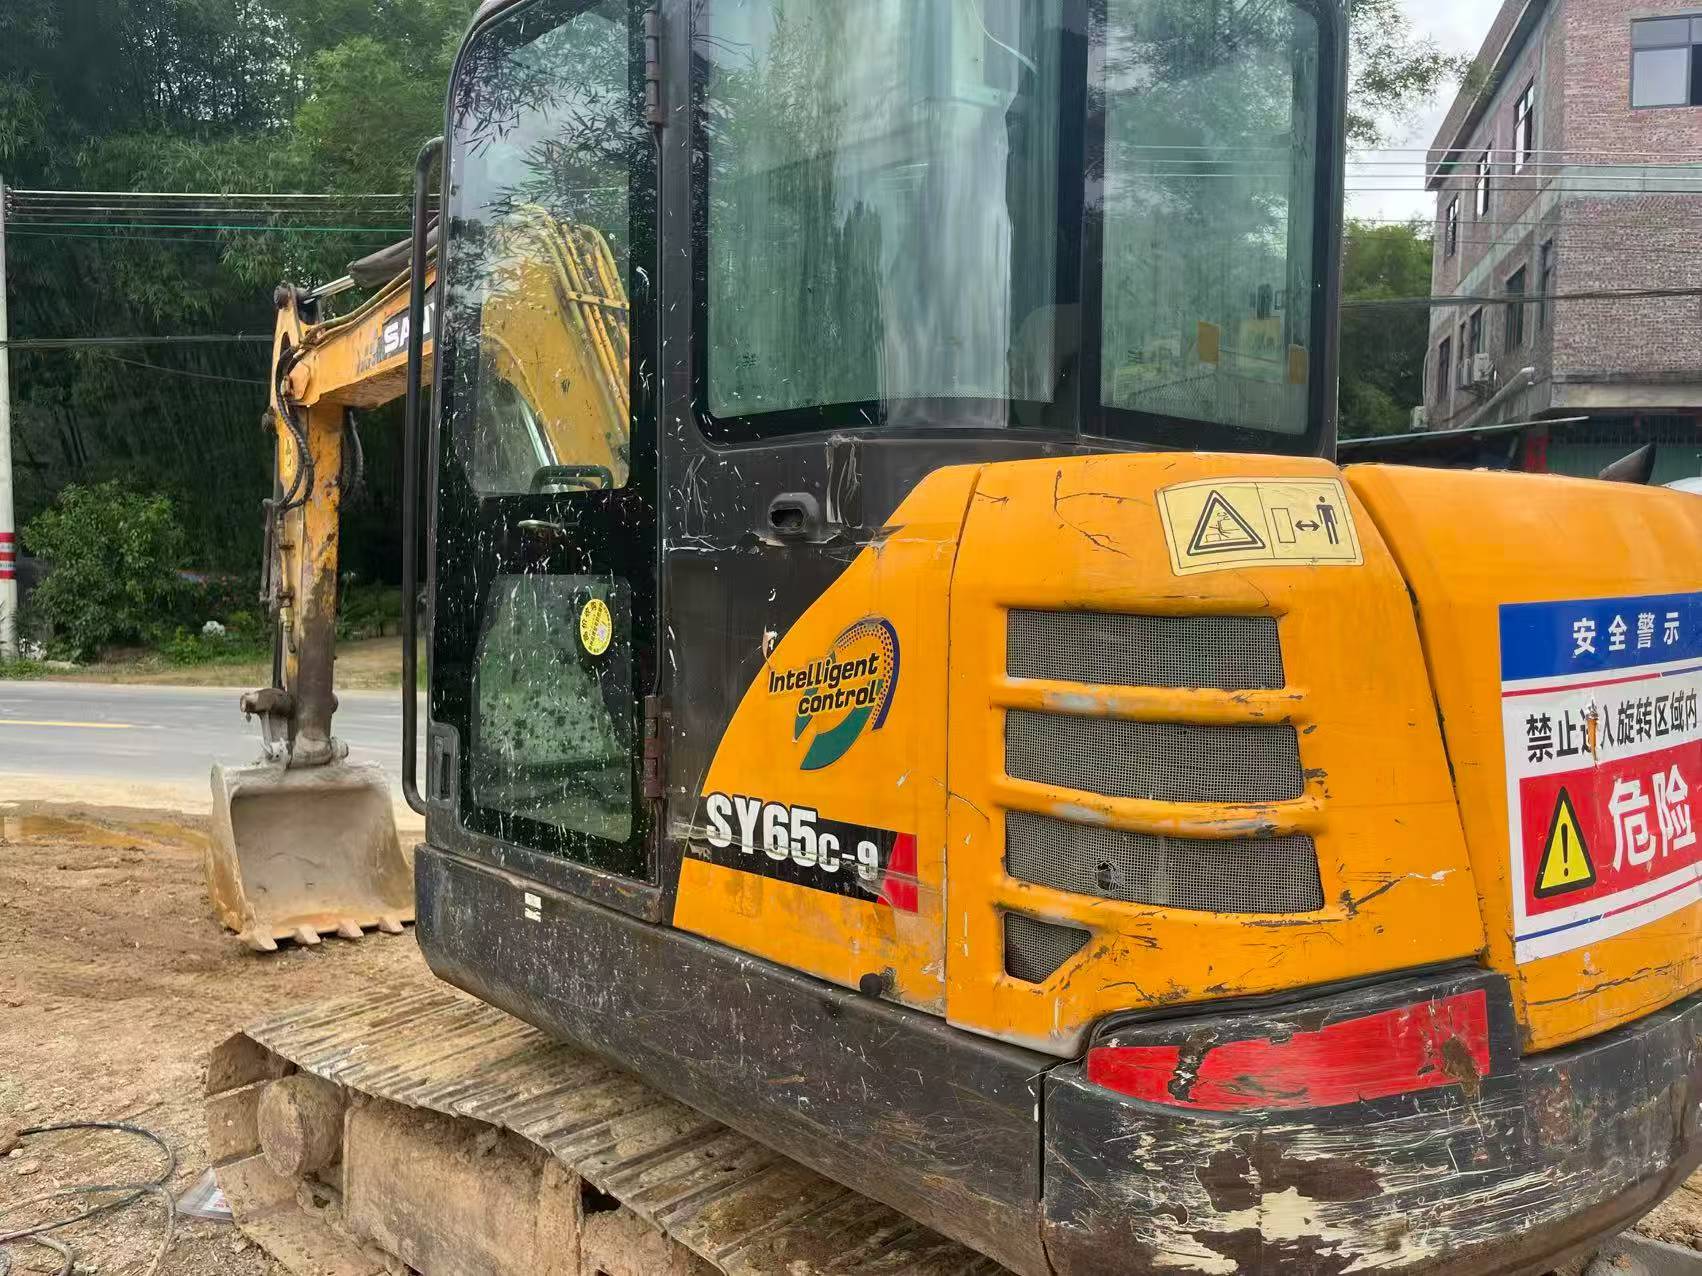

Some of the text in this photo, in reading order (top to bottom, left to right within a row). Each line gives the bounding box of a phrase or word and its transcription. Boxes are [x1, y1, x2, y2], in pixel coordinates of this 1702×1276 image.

[1573, 611, 1680, 656] 安全警示
[768, 652, 880, 693] Intelligent
[798, 680, 877, 715] control
[1608, 764, 1697, 872] 危险
